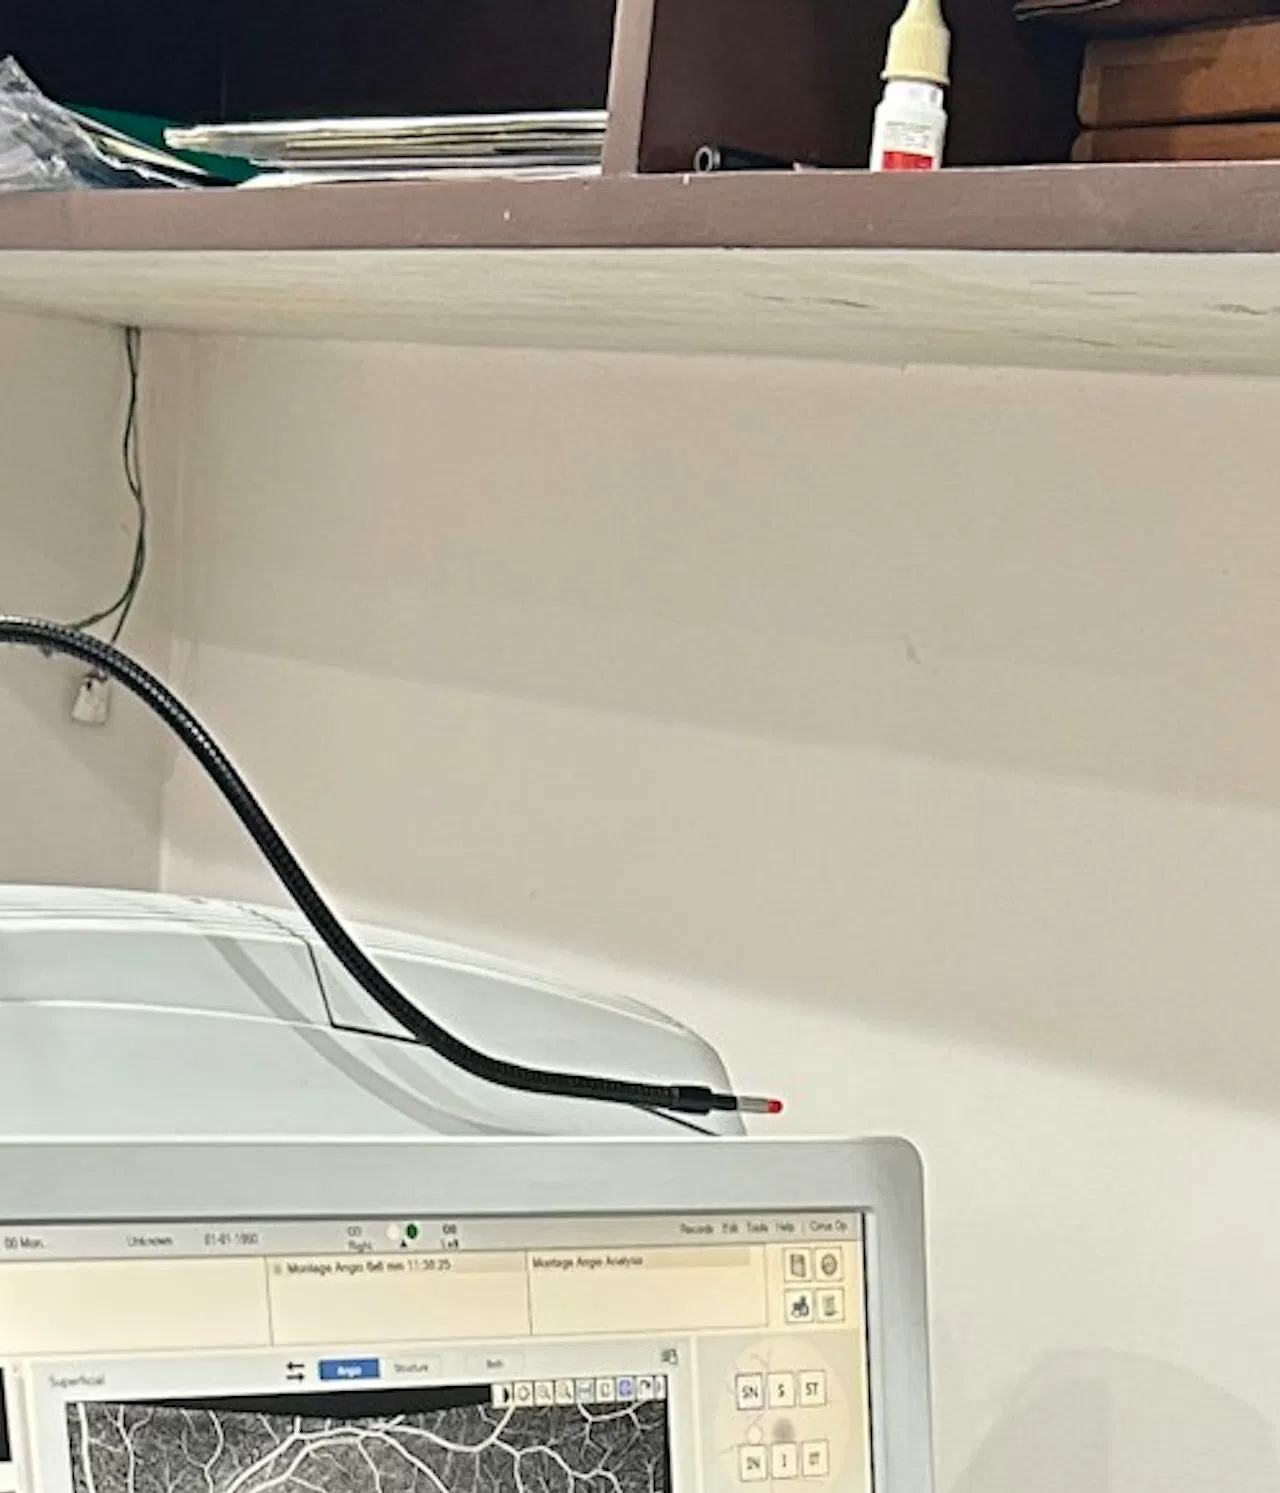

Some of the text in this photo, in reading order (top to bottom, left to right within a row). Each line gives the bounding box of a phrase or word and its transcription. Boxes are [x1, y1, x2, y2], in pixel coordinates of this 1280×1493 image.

[287, 1261, 332, 1275] Montage
[532, 1256, 573, 1270] Montage
[49, 1373, 105, 1389] Superficial
[805, 1382, 819, 1396] ST
